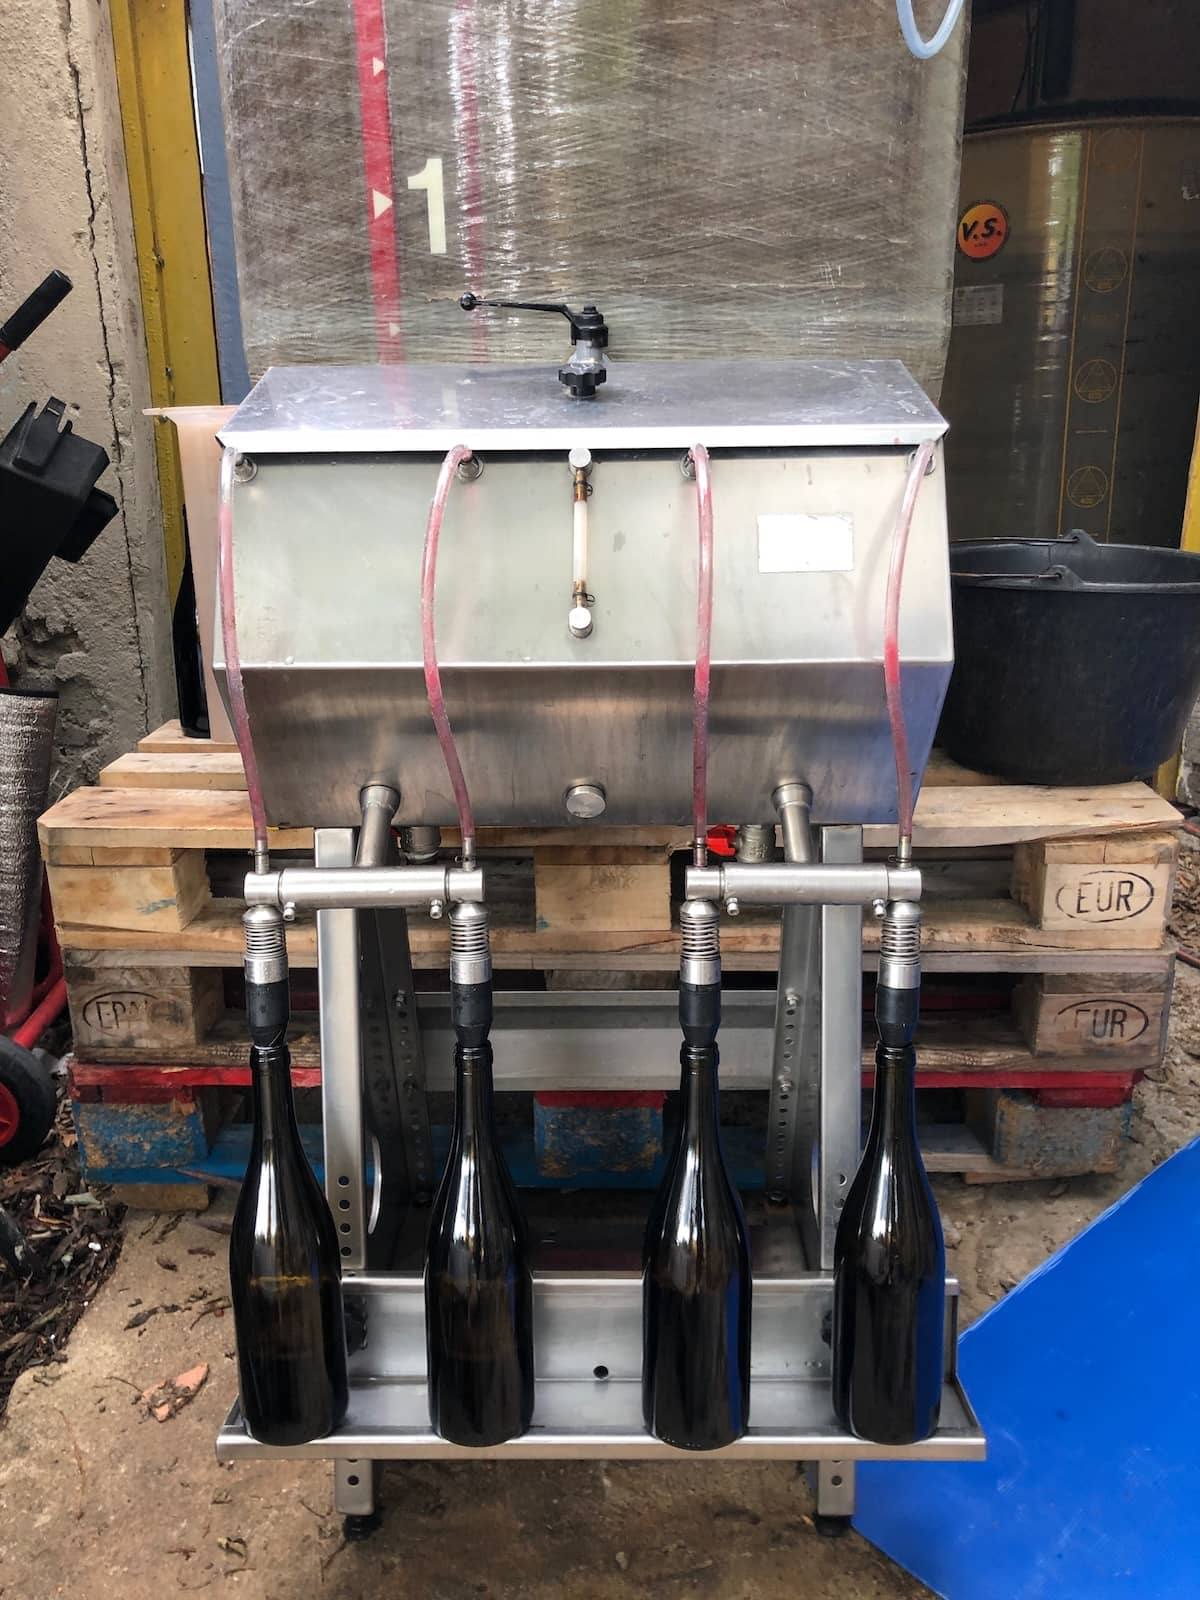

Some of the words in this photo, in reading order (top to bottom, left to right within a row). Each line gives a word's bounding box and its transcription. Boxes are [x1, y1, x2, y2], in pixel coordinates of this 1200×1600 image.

[407, 158, 447, 254] 1
[962, 217, 1003, 242] V.S.
[1076, 880, 1134, 914] EUR
